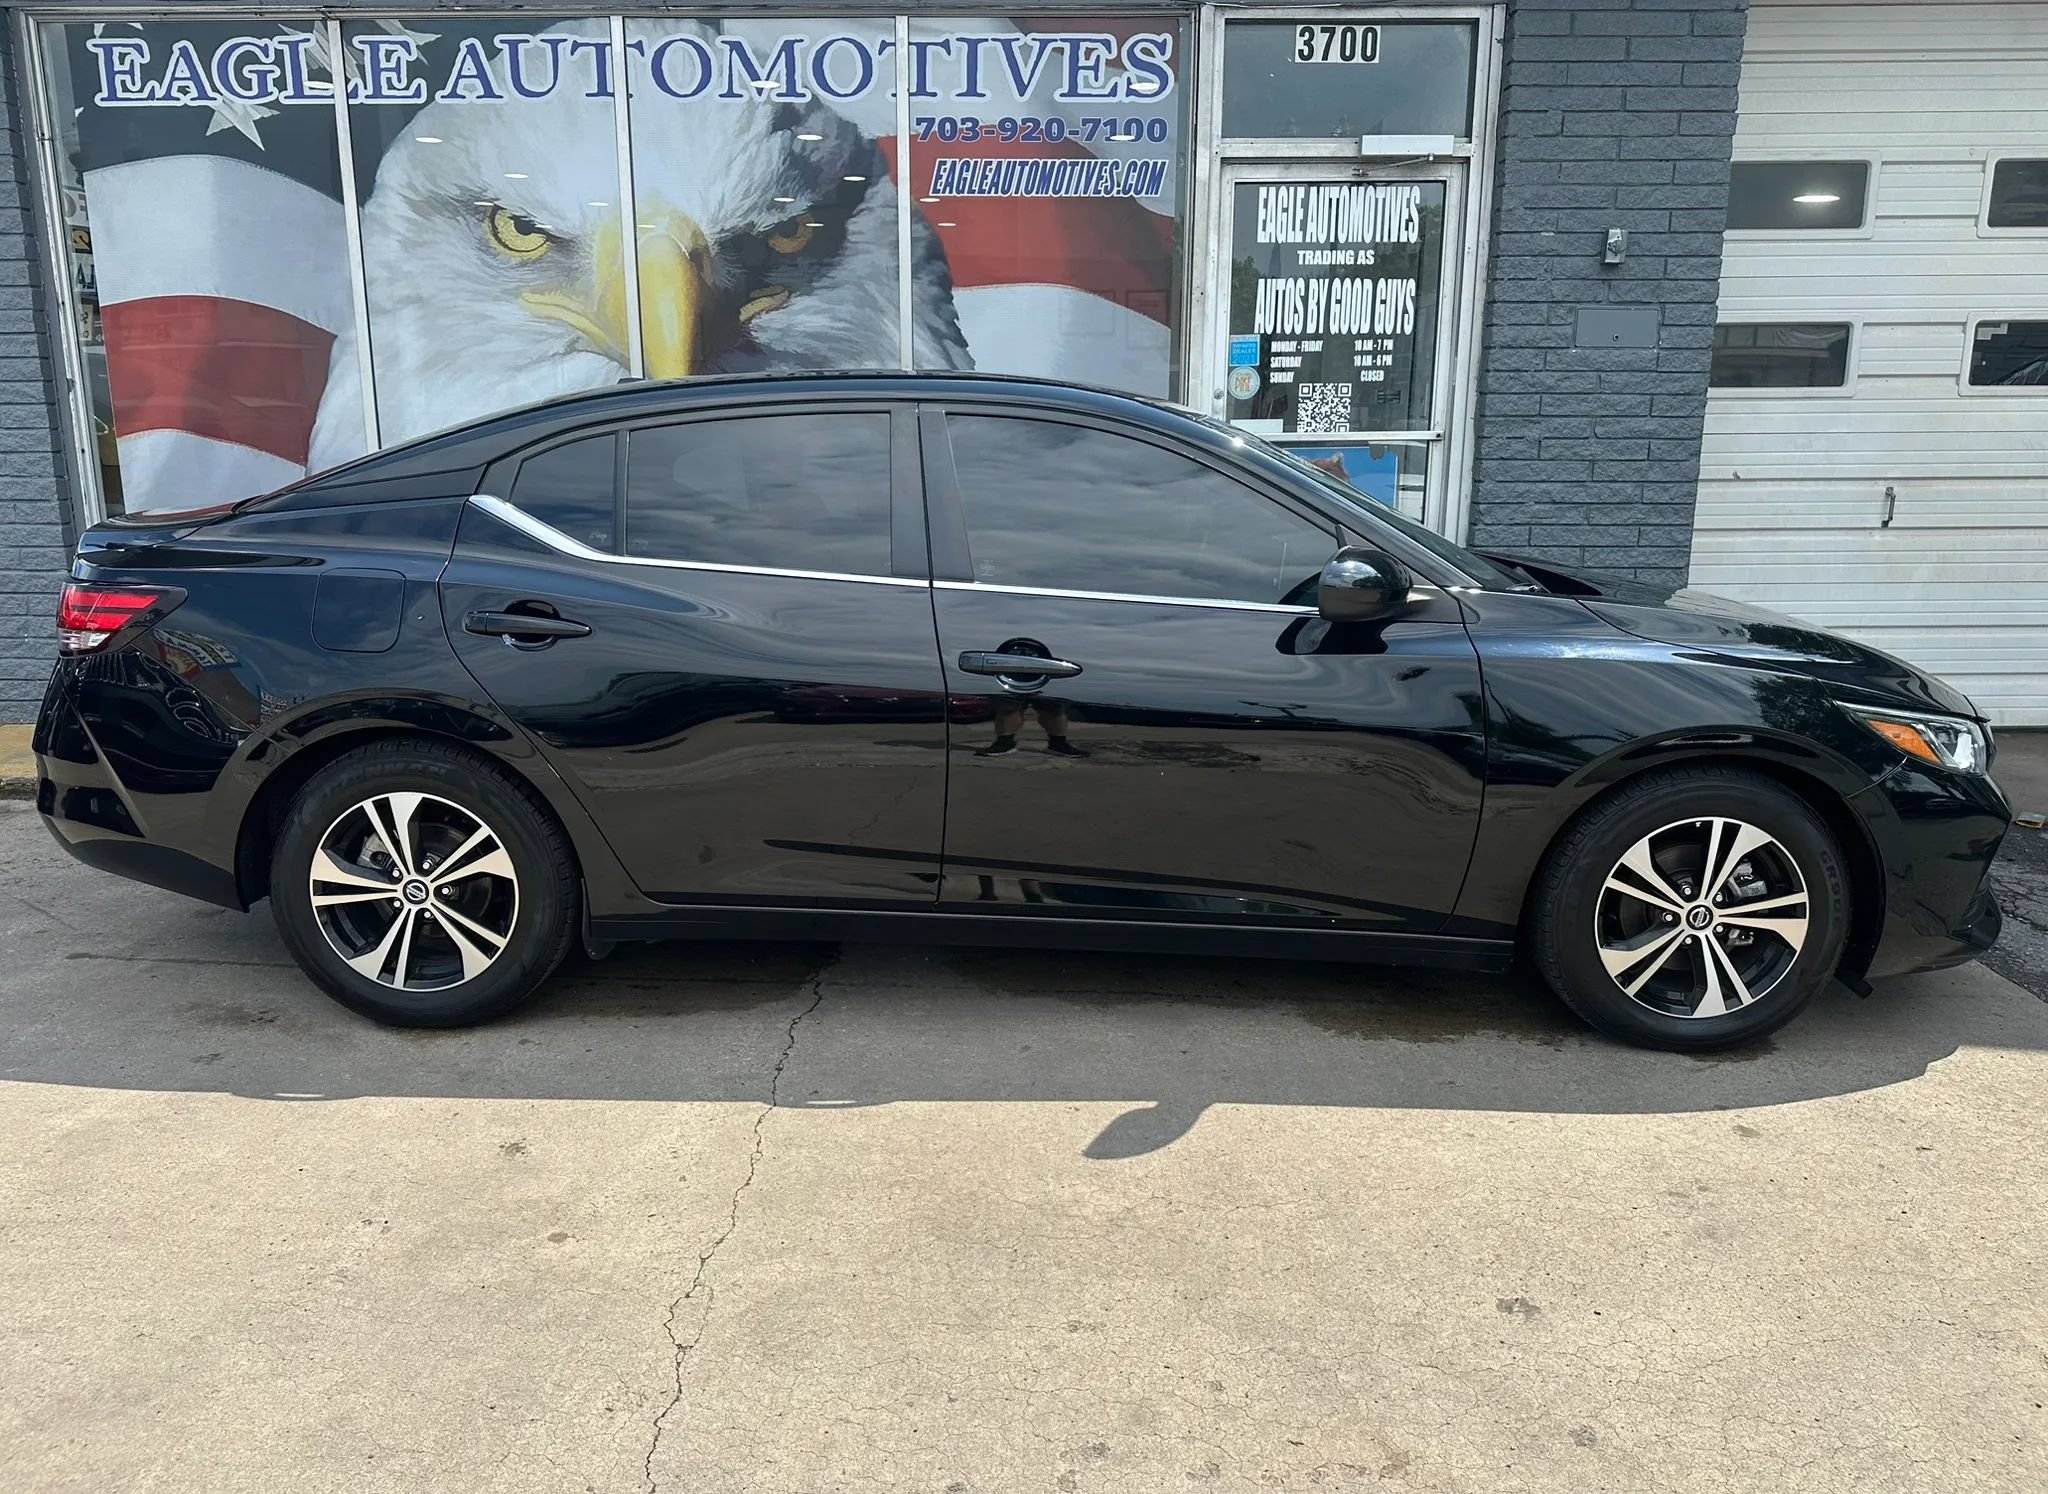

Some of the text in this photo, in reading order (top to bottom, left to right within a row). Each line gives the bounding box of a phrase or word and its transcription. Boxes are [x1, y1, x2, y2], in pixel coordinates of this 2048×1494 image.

[1298, 26, 1378, 62] 3700
[91, 33, 1174, 104] EAGLE AUTOMOTIVES
[915, 116, 1169, 144] 703-920-7100
[929, 158, 1168, 197] EAGLEAUTOMOTIVES.COM
[1257, 186, 1420, 243] EAGLE AUTOMOTIVES
[1297, 250, 1375, 265] TRADING AS
[1254, 278, 1416, 335] AUTOS BY GOOD GUYS
[1270, 356, 1302, 368] SATURDAY
[1353, 354, 1361, 367] 10
[1361, 354, 1372, 366] AM
[1376, 354, 1382, 366] 6
[1382, 354, 1393, 366] PM
[1271, 340, 1298, 352] MONDAY
[1301, 340, 1323, 352] FRIDAY
[1354, 339, 1362, 351] 10
[1362, 339, 1373, 351] AM
[1377, 339, 1382, 351] 7
[1383, 339, 1394, 351] PM
[1269, 369, 1385, 383] SUNDAY CLOSED
